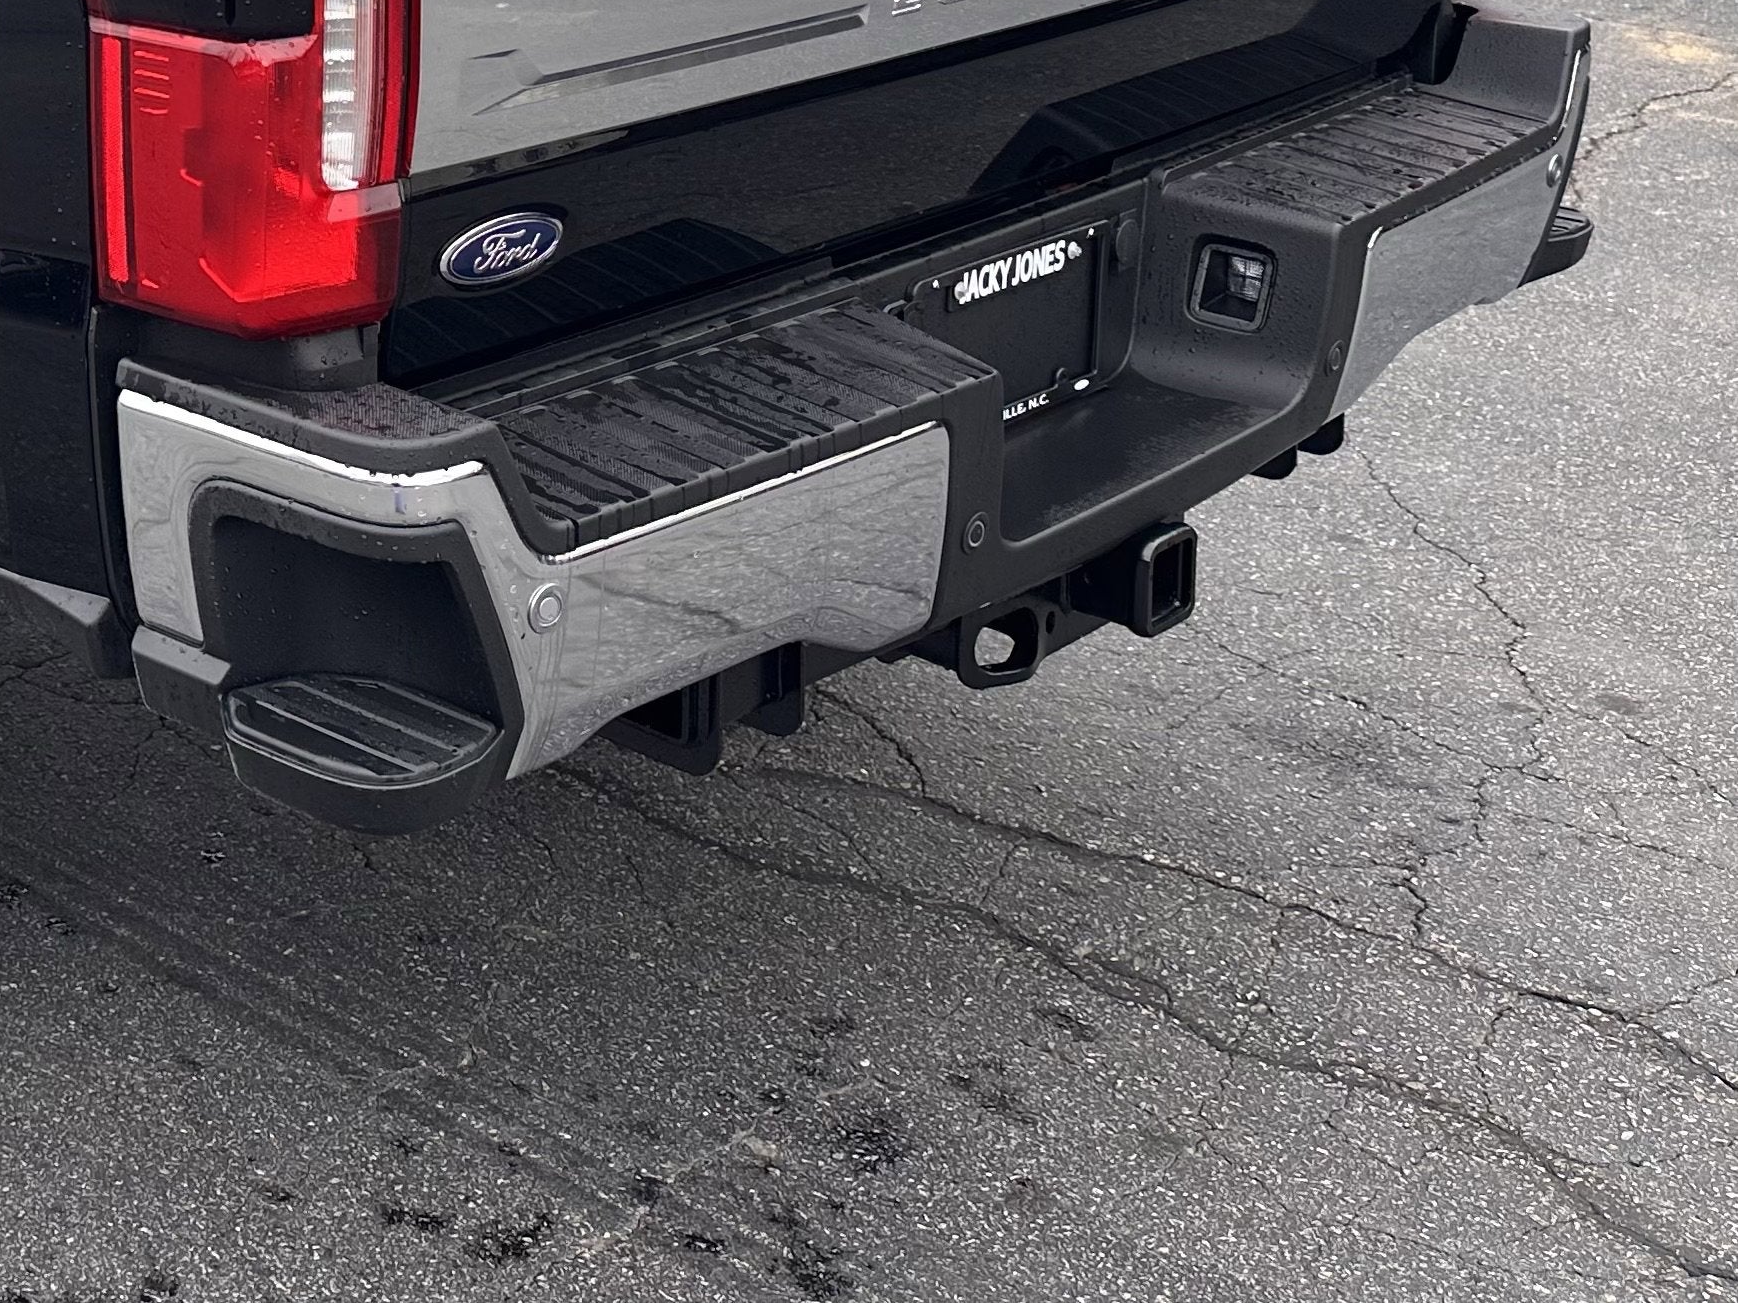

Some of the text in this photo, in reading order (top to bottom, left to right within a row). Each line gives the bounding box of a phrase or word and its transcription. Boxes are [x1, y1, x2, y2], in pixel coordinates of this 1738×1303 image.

[473, 228, 541, 274] Ford
[959, 239, 1066, 305] JACKY JONES
